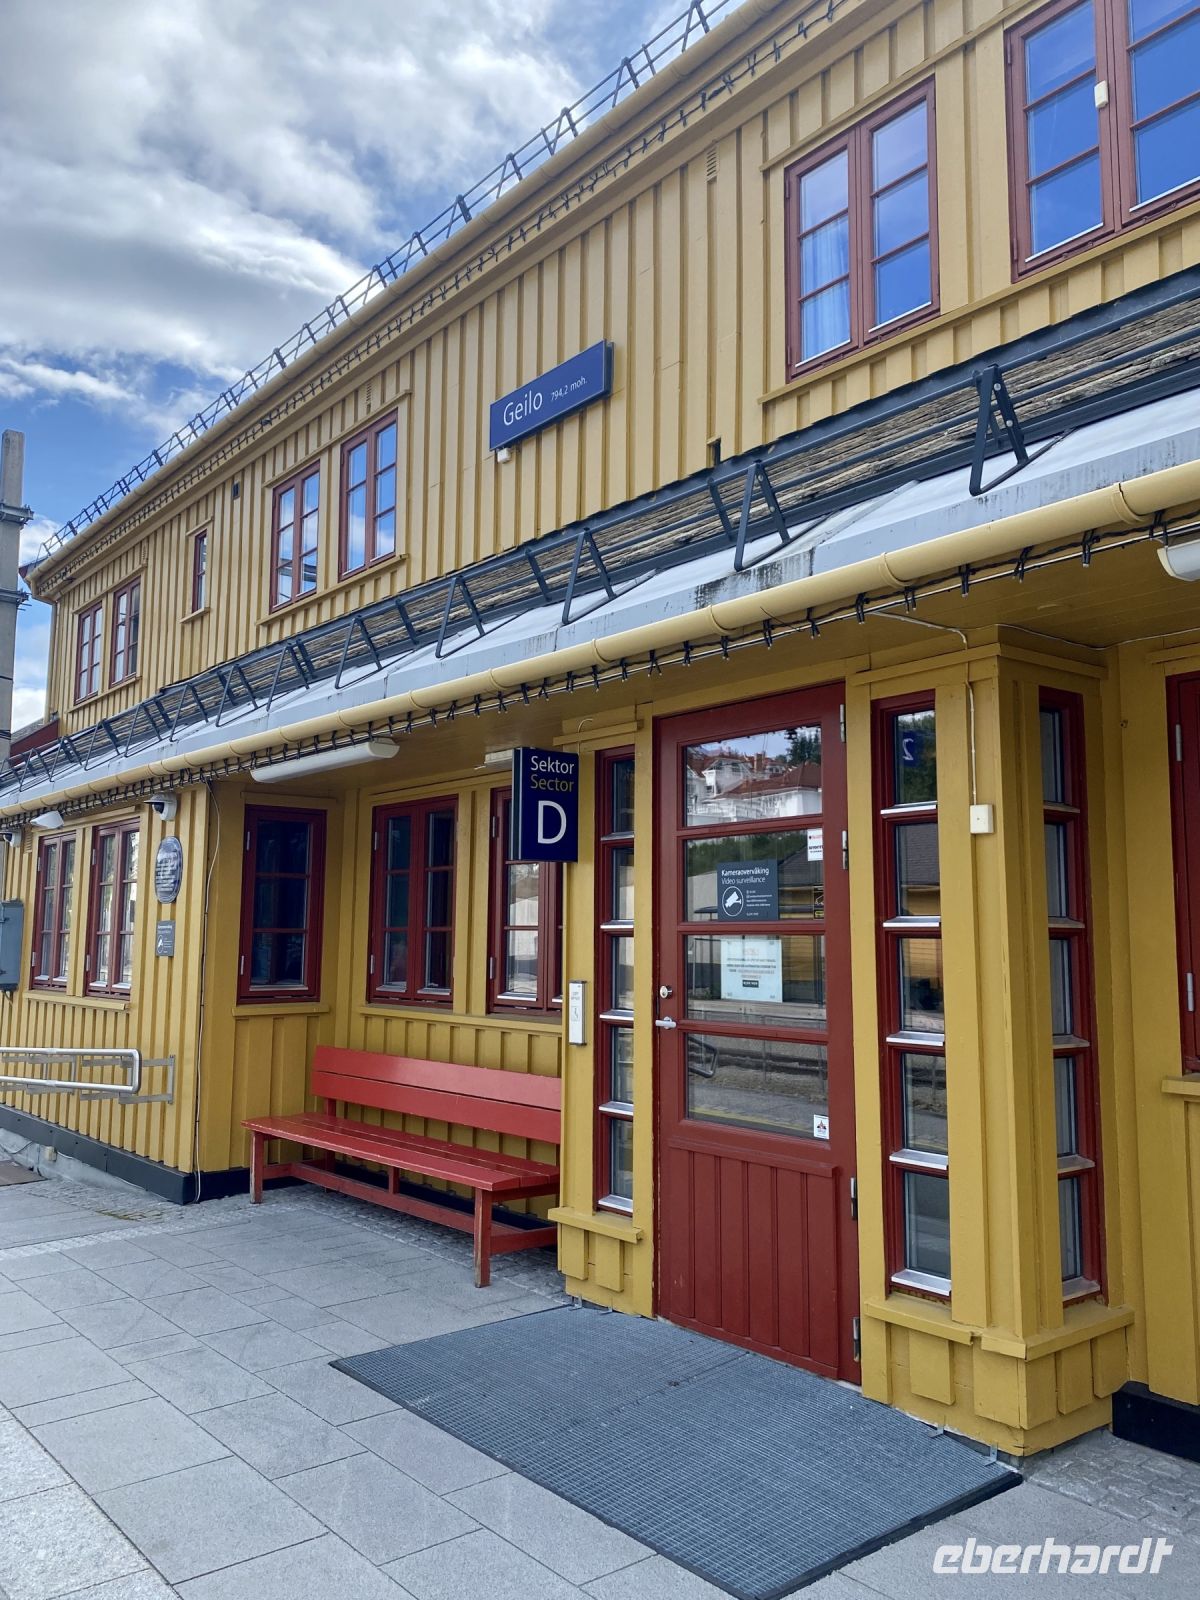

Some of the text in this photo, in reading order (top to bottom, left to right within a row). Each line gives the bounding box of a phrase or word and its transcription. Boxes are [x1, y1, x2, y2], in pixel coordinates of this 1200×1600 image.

[503, 390, 543, 426] Geilo
[530, 755, 574, 774] Sektor
[530, 773, 574, 792] Sector
[537, 800, 567, 844] D
[721, 867, 770, 876] Kameraovervåking
[721, 876, 766, 885] Video surveillance
